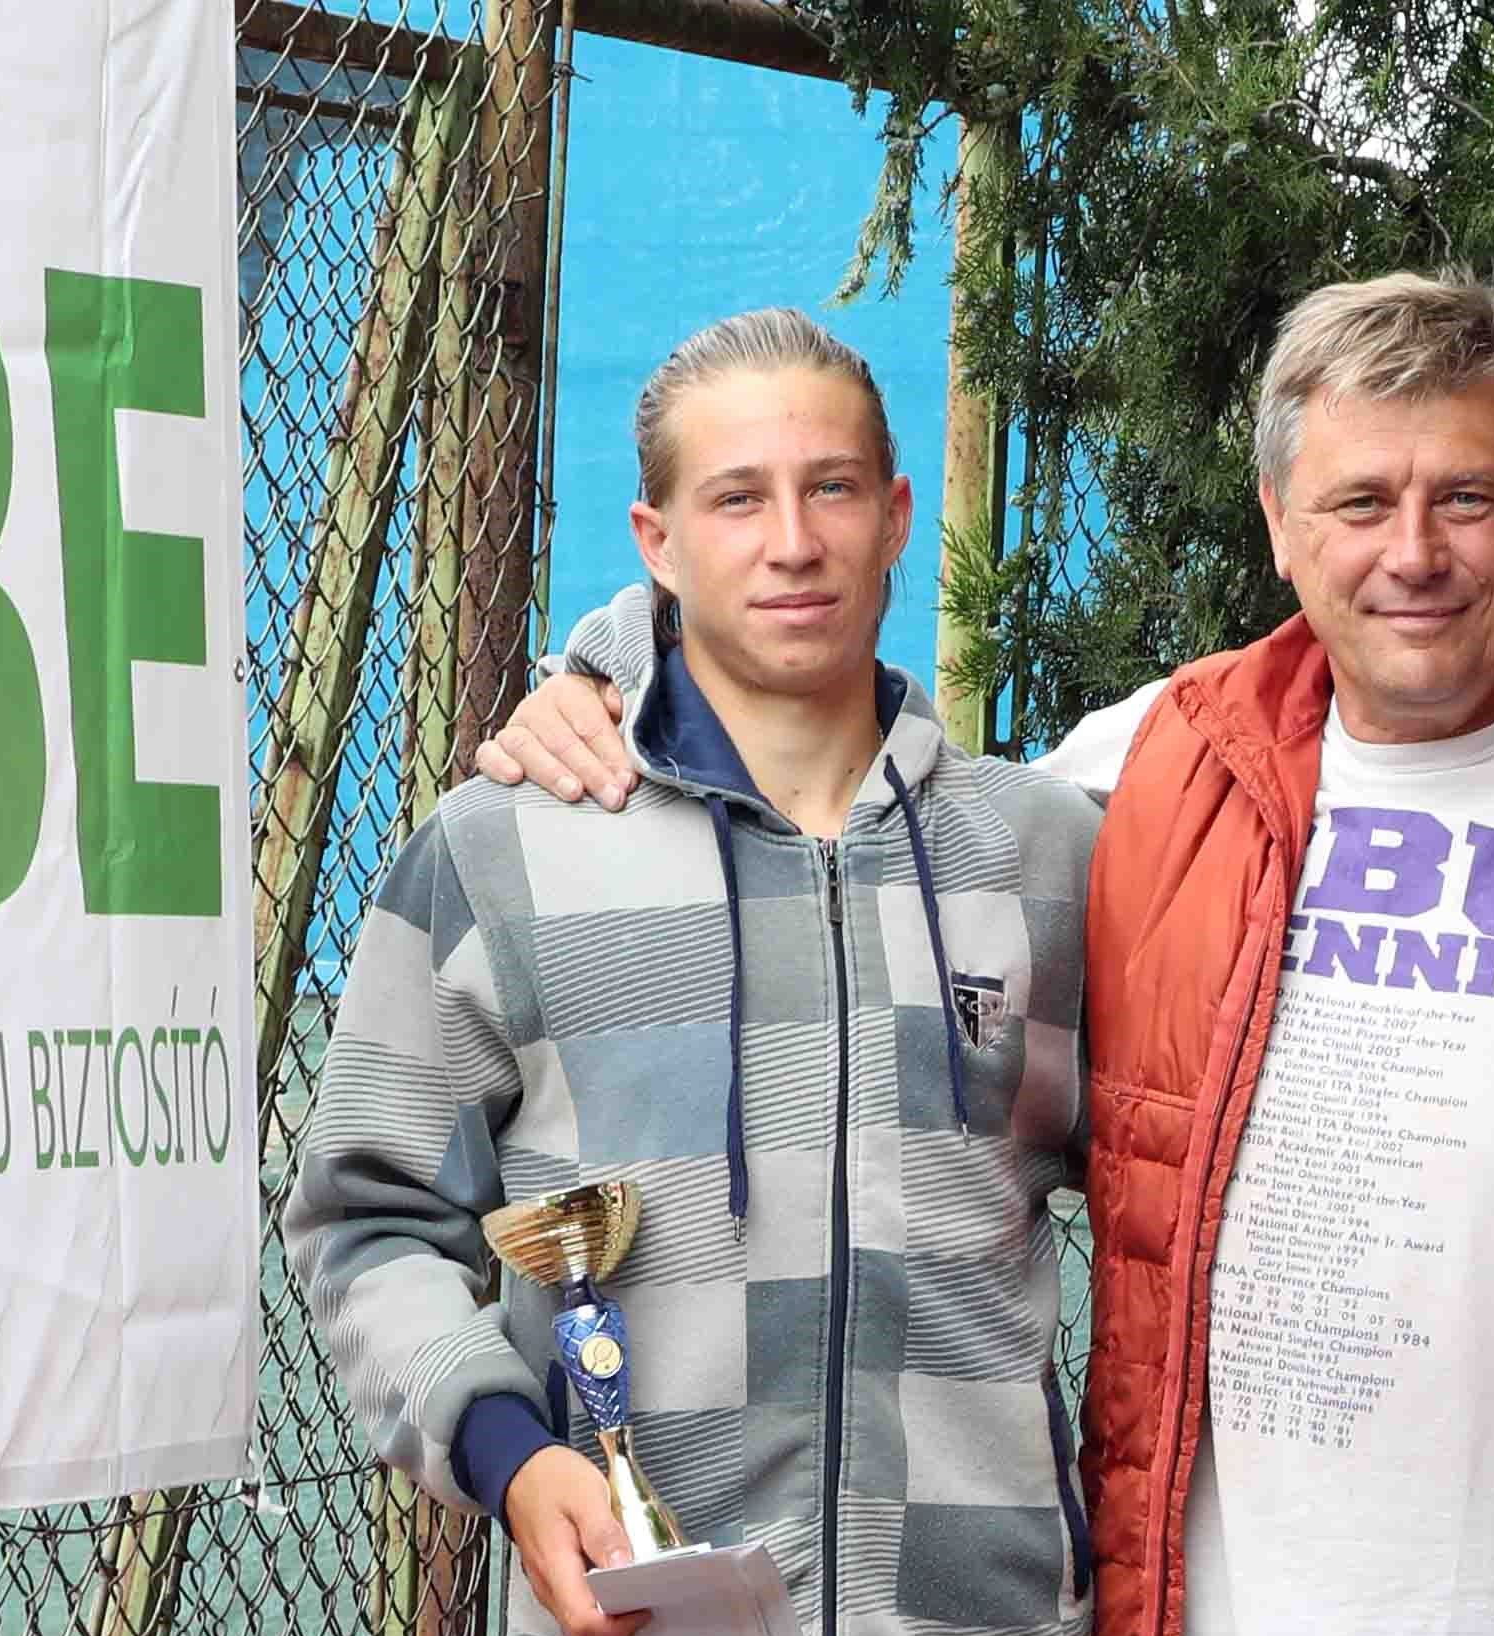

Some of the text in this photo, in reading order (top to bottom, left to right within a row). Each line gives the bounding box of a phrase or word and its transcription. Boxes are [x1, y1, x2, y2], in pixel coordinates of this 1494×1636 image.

[1305, 991, 1355, 1008] National
[1300, 1019, 1351, 1036] National
[26, 985, 232, 1170] BIZTOSÍTÓ
[1265, 1042, 1293, 1057] uper
[1336, 1053, 1375, 1070] Singles
[1380, 1060, 1443, 1080] Champion
[1275, 1070, 1327, 1089] National
[1358, 1082, 1399, 1100] Singles
[1404, 1089, 1467, 1110] Champion
[1242, 1132, 1273, 1147] SIDA
[1278, 1137, 1335, 1157] Academic
[1260, 1107, 1311, 1126] National
[1343, 1120, 1394, 1139] Doubles
[1398, 1128, 1467, 1151] Champions
[1270, 1175, 1303, 1192] Jones
[1248, 1213, 1298, 1233] National
[1302, 1222, 1344, 1240] Arthur
[1348, 1229, 1379, 1245] Ashe
[1403, 1235, 1444, 1254] Award
[1320, 1278, 1390, 1302] Champions
[1229, 1322, 1284, 1342] National
[1287, 1331, 1324, 1351] Singles
[1329, 1338, 1393, 1362] Champion
[1268, 1312, 1300, 1329] Team
[1304, 1318, 1379, 1344] Champions
[1393, 1330, 1430, 1350] 1984
[1219, 1347, 1274, 1369] National
[1277, 1357, 1322, 1376] Doubles
[1326, 1365, 1395, 1389] Champions
[1307, 1391, 1373, 1415] Champions
